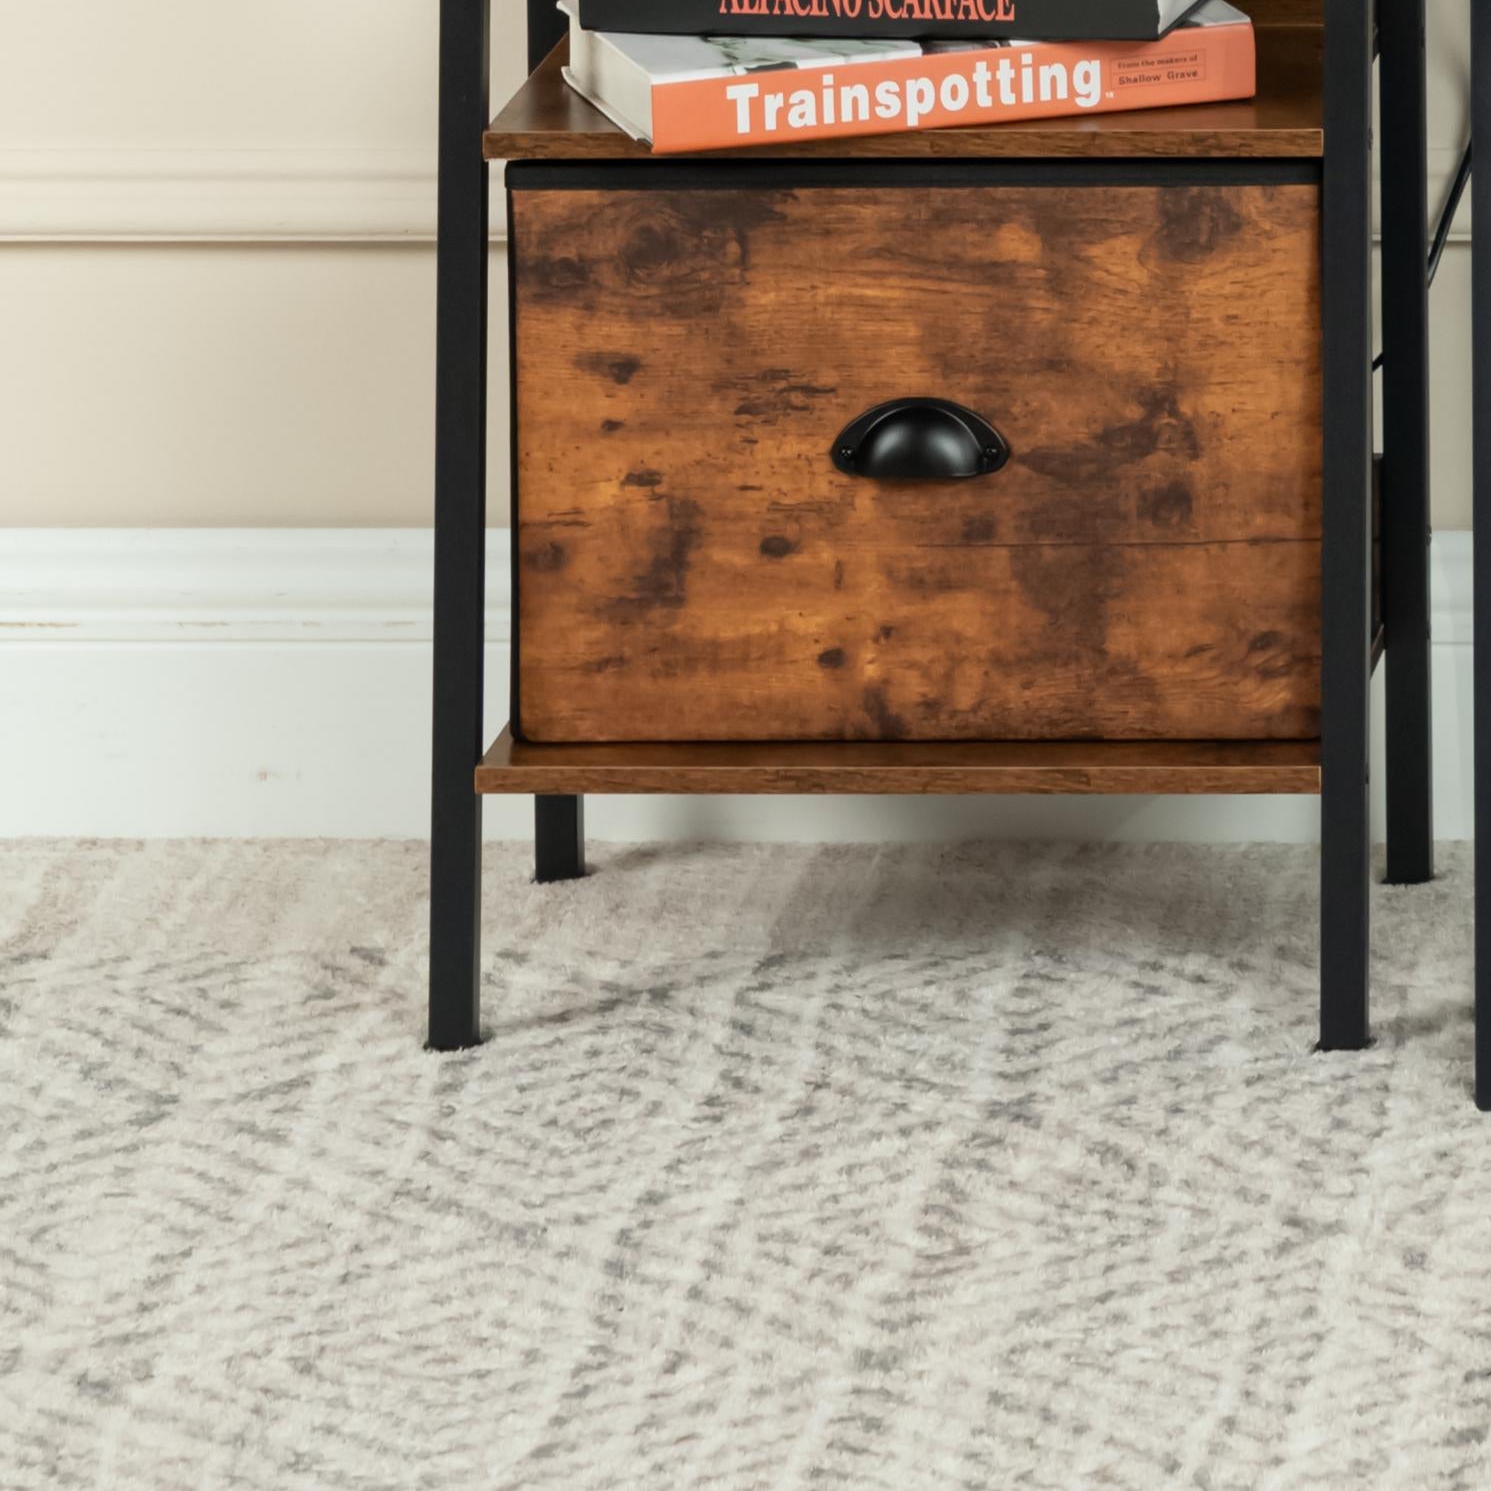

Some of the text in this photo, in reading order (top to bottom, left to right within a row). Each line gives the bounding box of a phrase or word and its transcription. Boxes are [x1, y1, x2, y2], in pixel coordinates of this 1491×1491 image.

[1141, 59, 1155, 67] the
[1118, 69, 1199, 86] Shallow Grave
[726, 52, 1103, 134] Trainspotting
